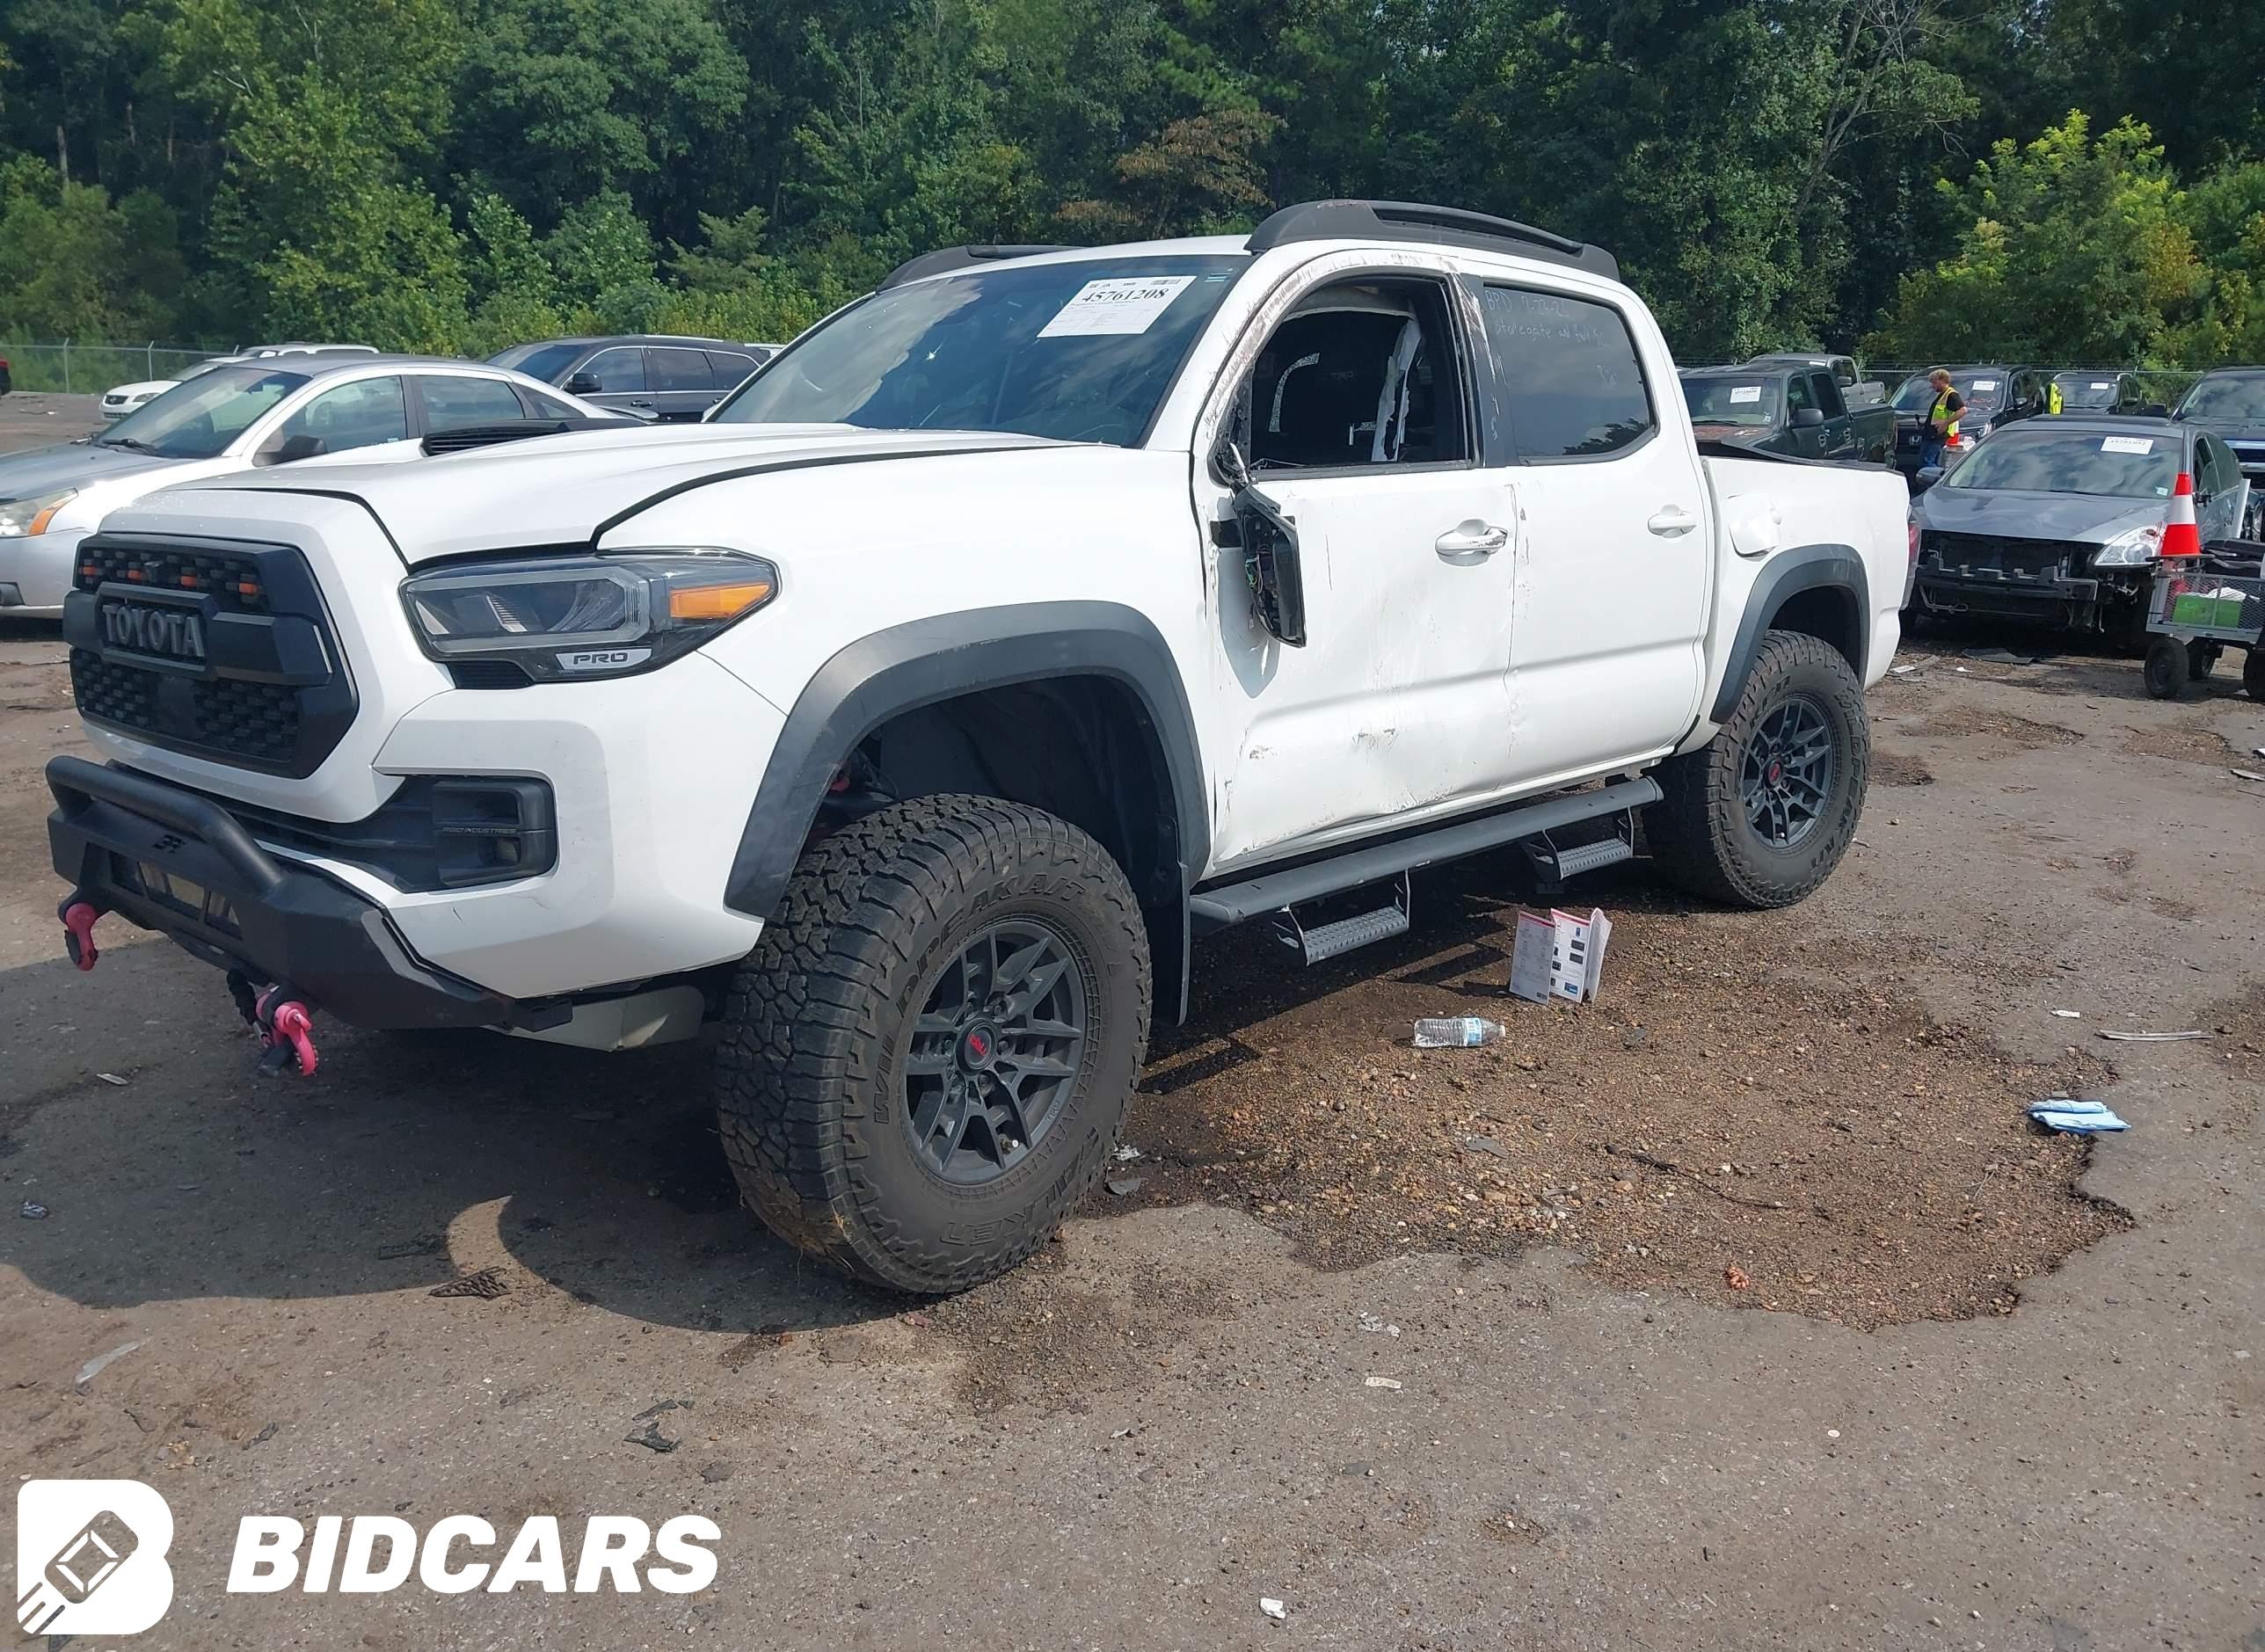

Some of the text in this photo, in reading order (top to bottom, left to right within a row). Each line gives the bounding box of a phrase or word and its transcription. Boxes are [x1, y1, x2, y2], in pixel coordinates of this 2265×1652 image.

[1082, 287, 1169, 302] 45761208
[102, 603, 205, 658] TOYOTA
[572, 652, 629, 665] PRO
